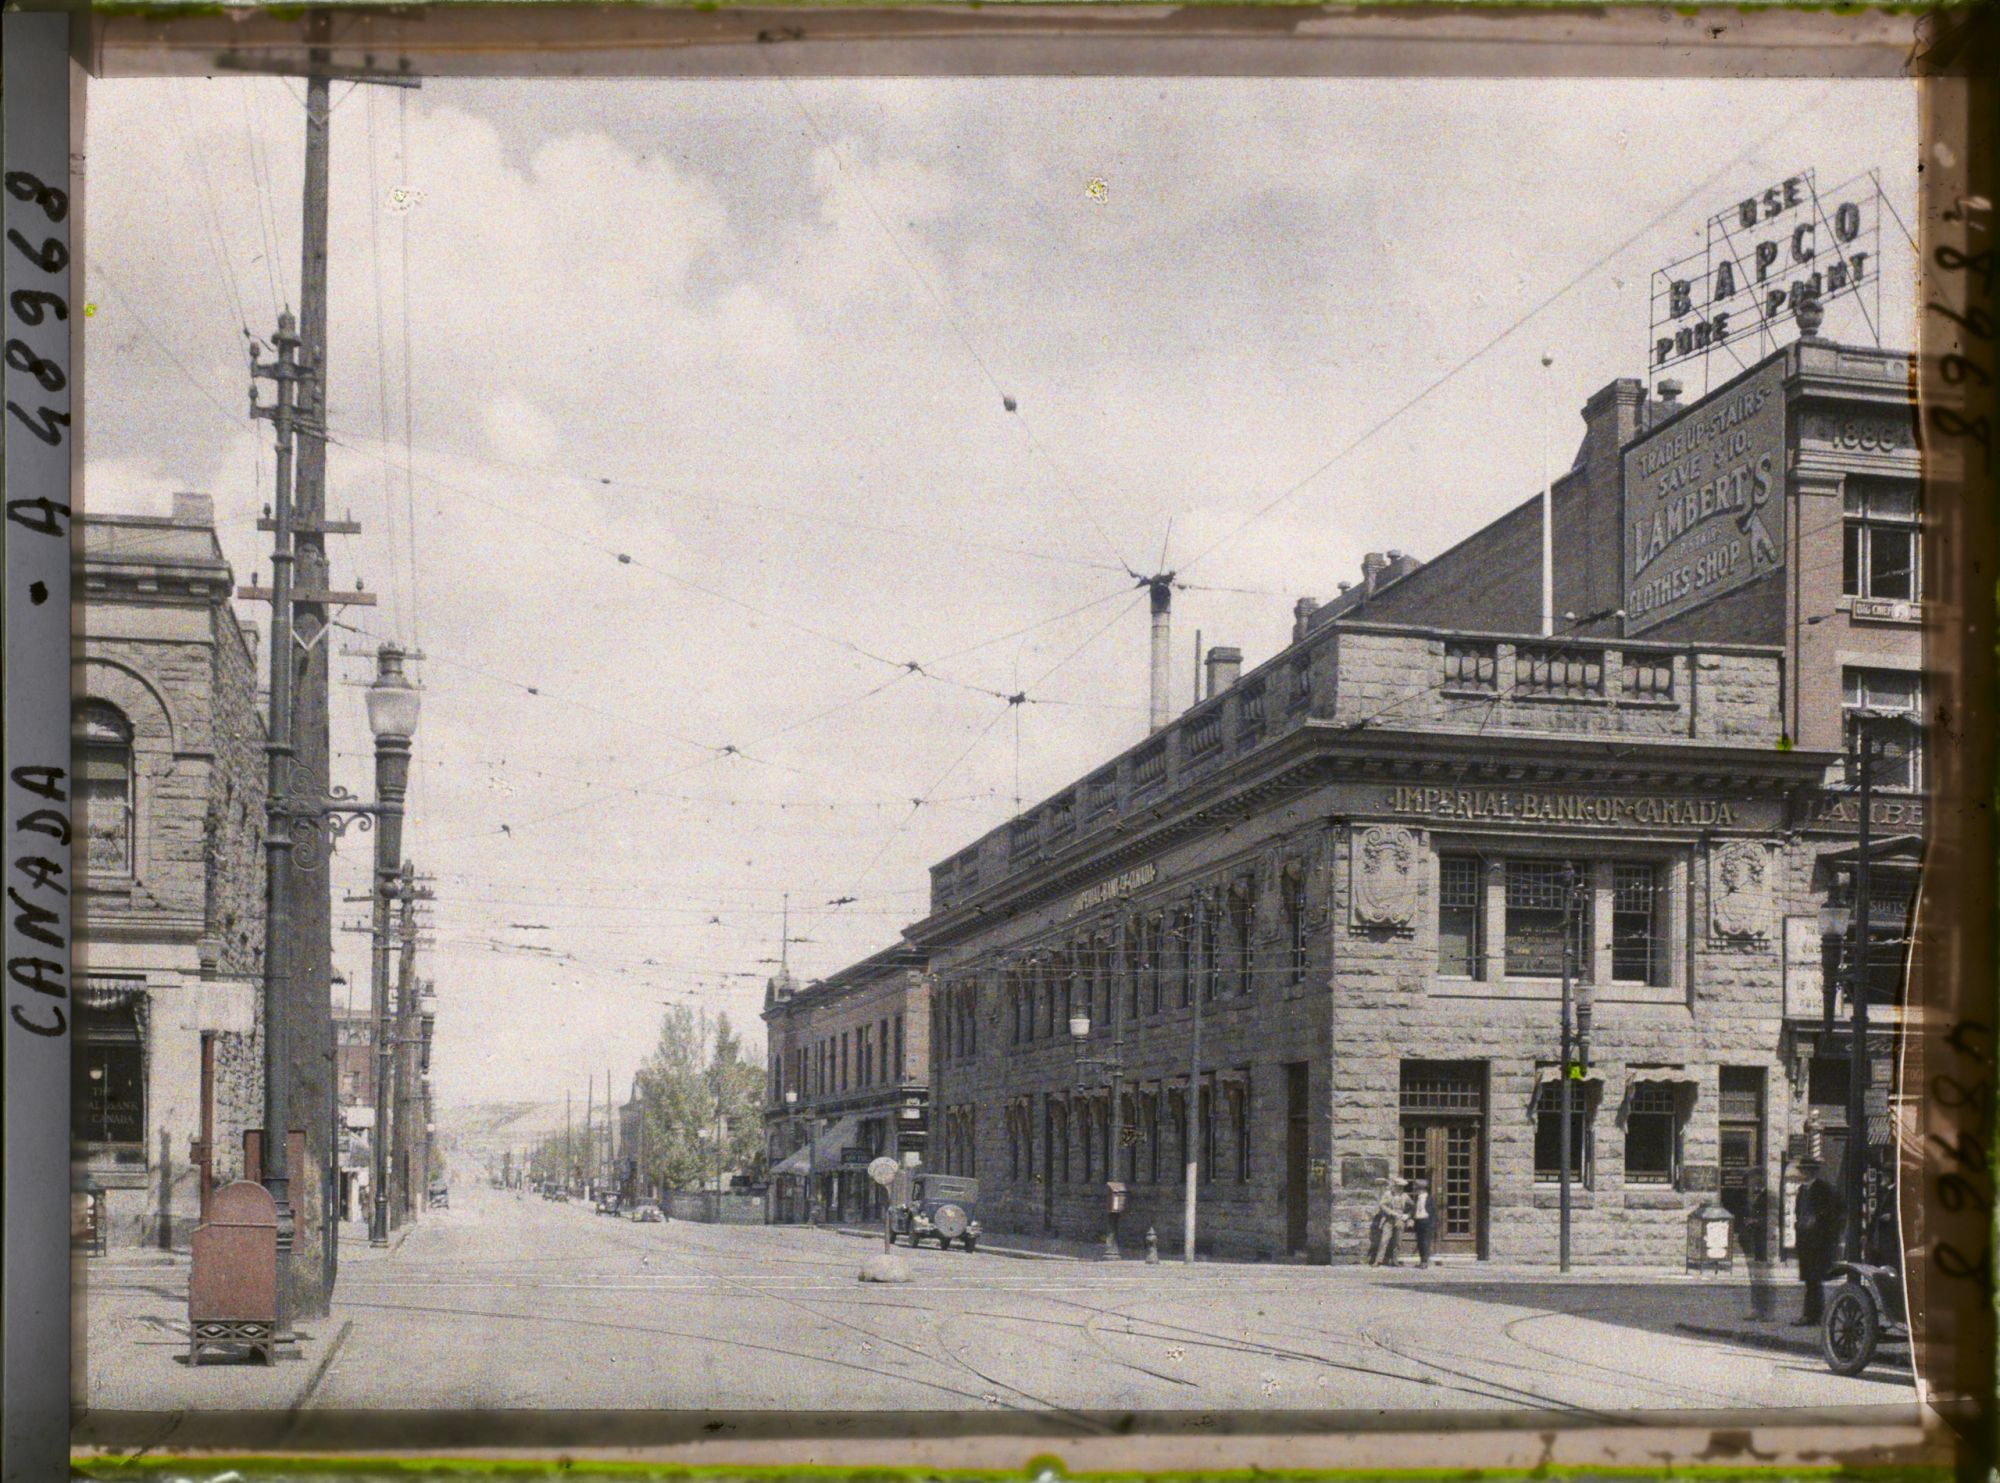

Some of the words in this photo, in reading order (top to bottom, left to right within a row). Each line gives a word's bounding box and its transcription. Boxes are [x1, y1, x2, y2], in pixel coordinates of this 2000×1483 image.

[1739, 177, 1801, 228] USE
[1670, 202, 1860, 319] BAPCO
[4, 170, 70, 445] 48968
[1656, 312, 1730, 364] PURE
[1640, 436, 1681, 478] TRADE
[1658, 455, 1701, 499] SAVE
[7, 497, 70, 537] A
[1633, 452, 1773, 579] LAMBERT'S
[1629, 566, 1690, 619] CLOTHES
[1695, 540, 1741, 590] SHOP
[1393, 784, 1515, 818] IMPERIAL
[1520, 792, 1593, 821] BANK
[1594, 797, 1625, 823] OF
[1634, 798, 1736, 826] CANADA
[7, 765, 70, 1036] CANADA
